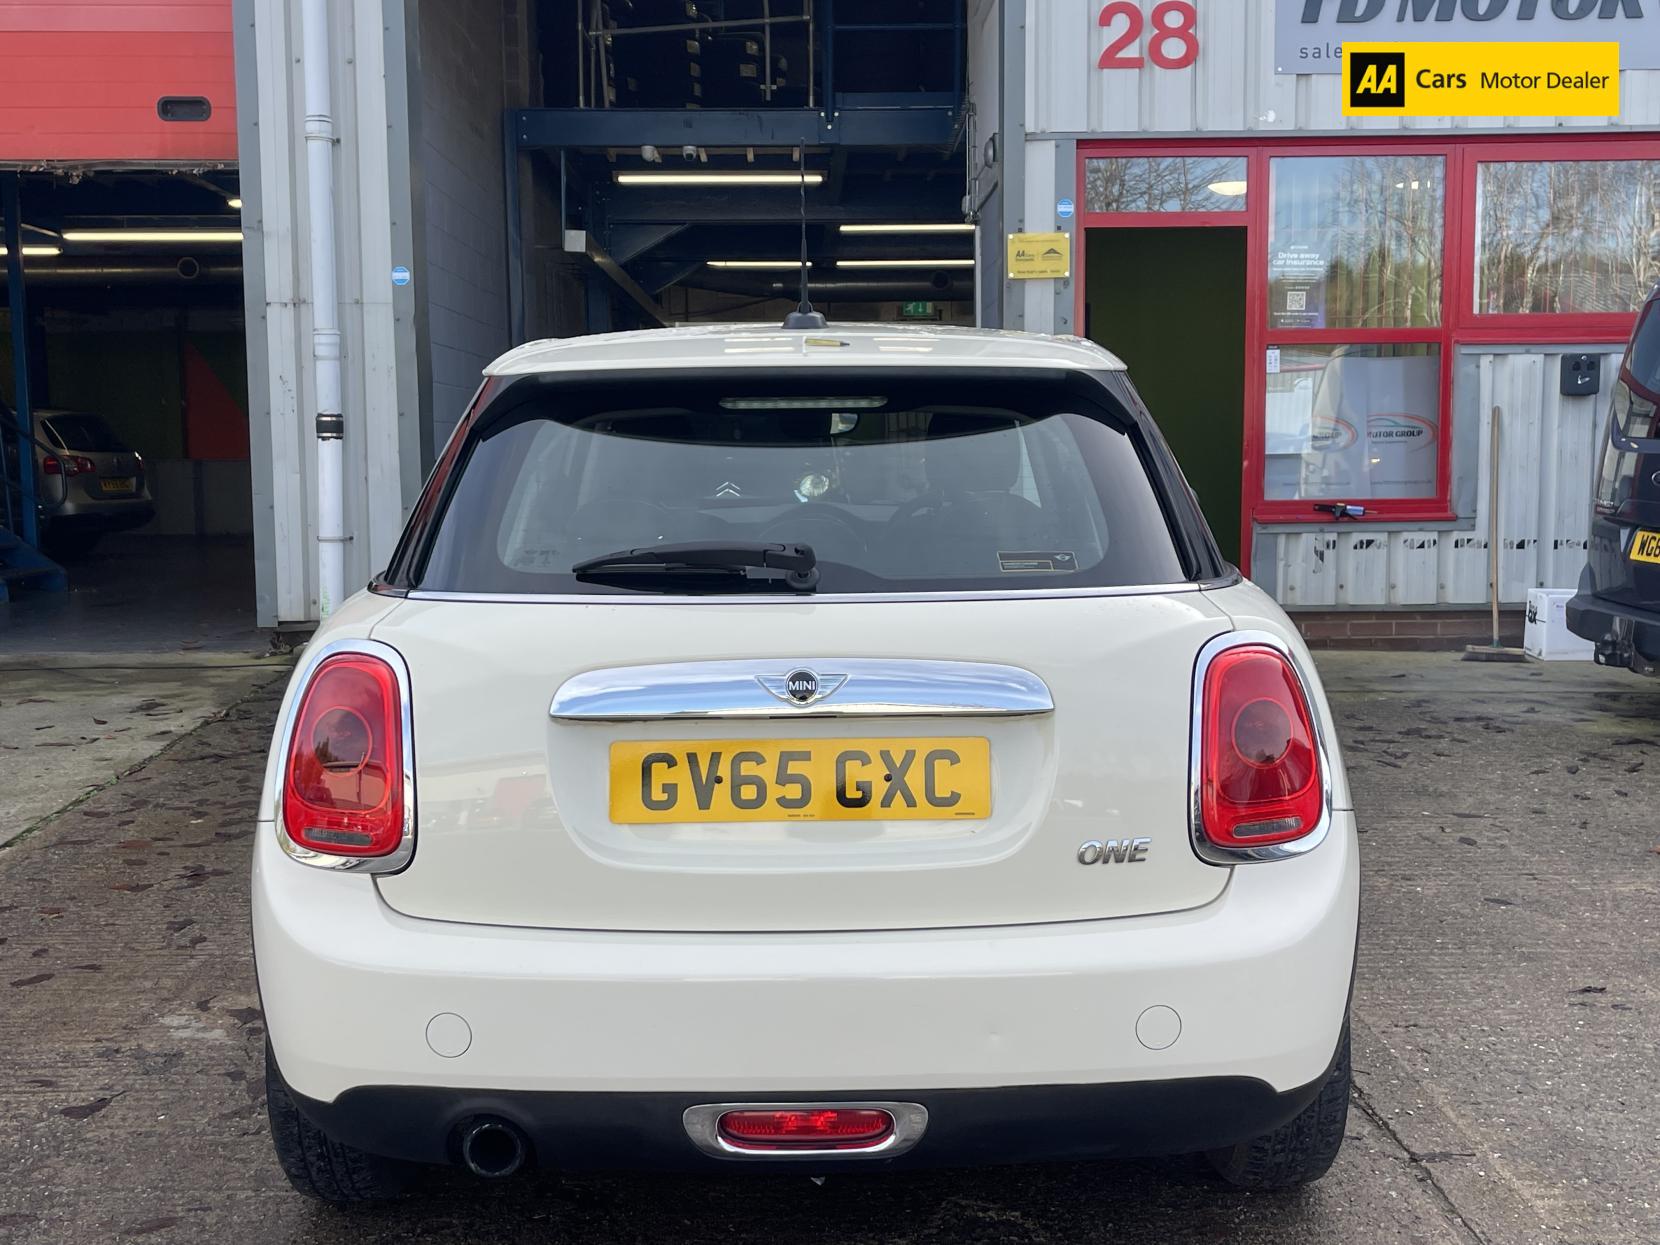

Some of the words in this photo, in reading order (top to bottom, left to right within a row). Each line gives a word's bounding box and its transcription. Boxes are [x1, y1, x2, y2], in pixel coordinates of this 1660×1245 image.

[1097, 1, 1199, 70] 28
[1395, 429, 1424, 438] GROUP
[789, 680, 816, 691] MINI
[641, 751, 812, 811] GV65
[835, 749, 962, 809] GXC
[1078, 837, 1153, 866] ONE
